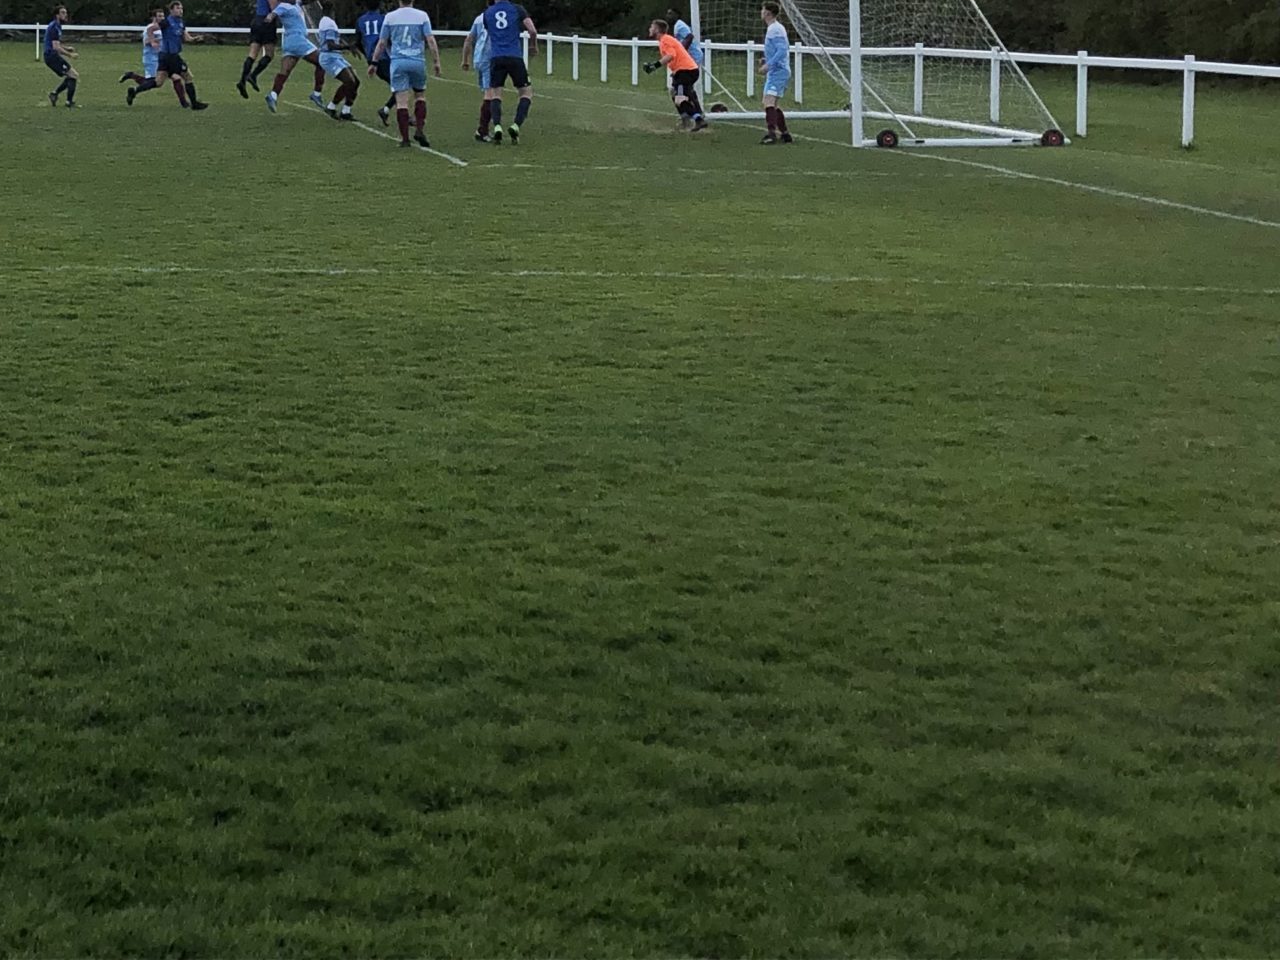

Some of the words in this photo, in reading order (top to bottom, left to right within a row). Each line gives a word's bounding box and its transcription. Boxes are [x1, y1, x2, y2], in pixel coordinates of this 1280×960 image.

[364, 20, 379, 36] 11
[495, 10, 508, 29] 8
[402, 26, 412, 46] 4
